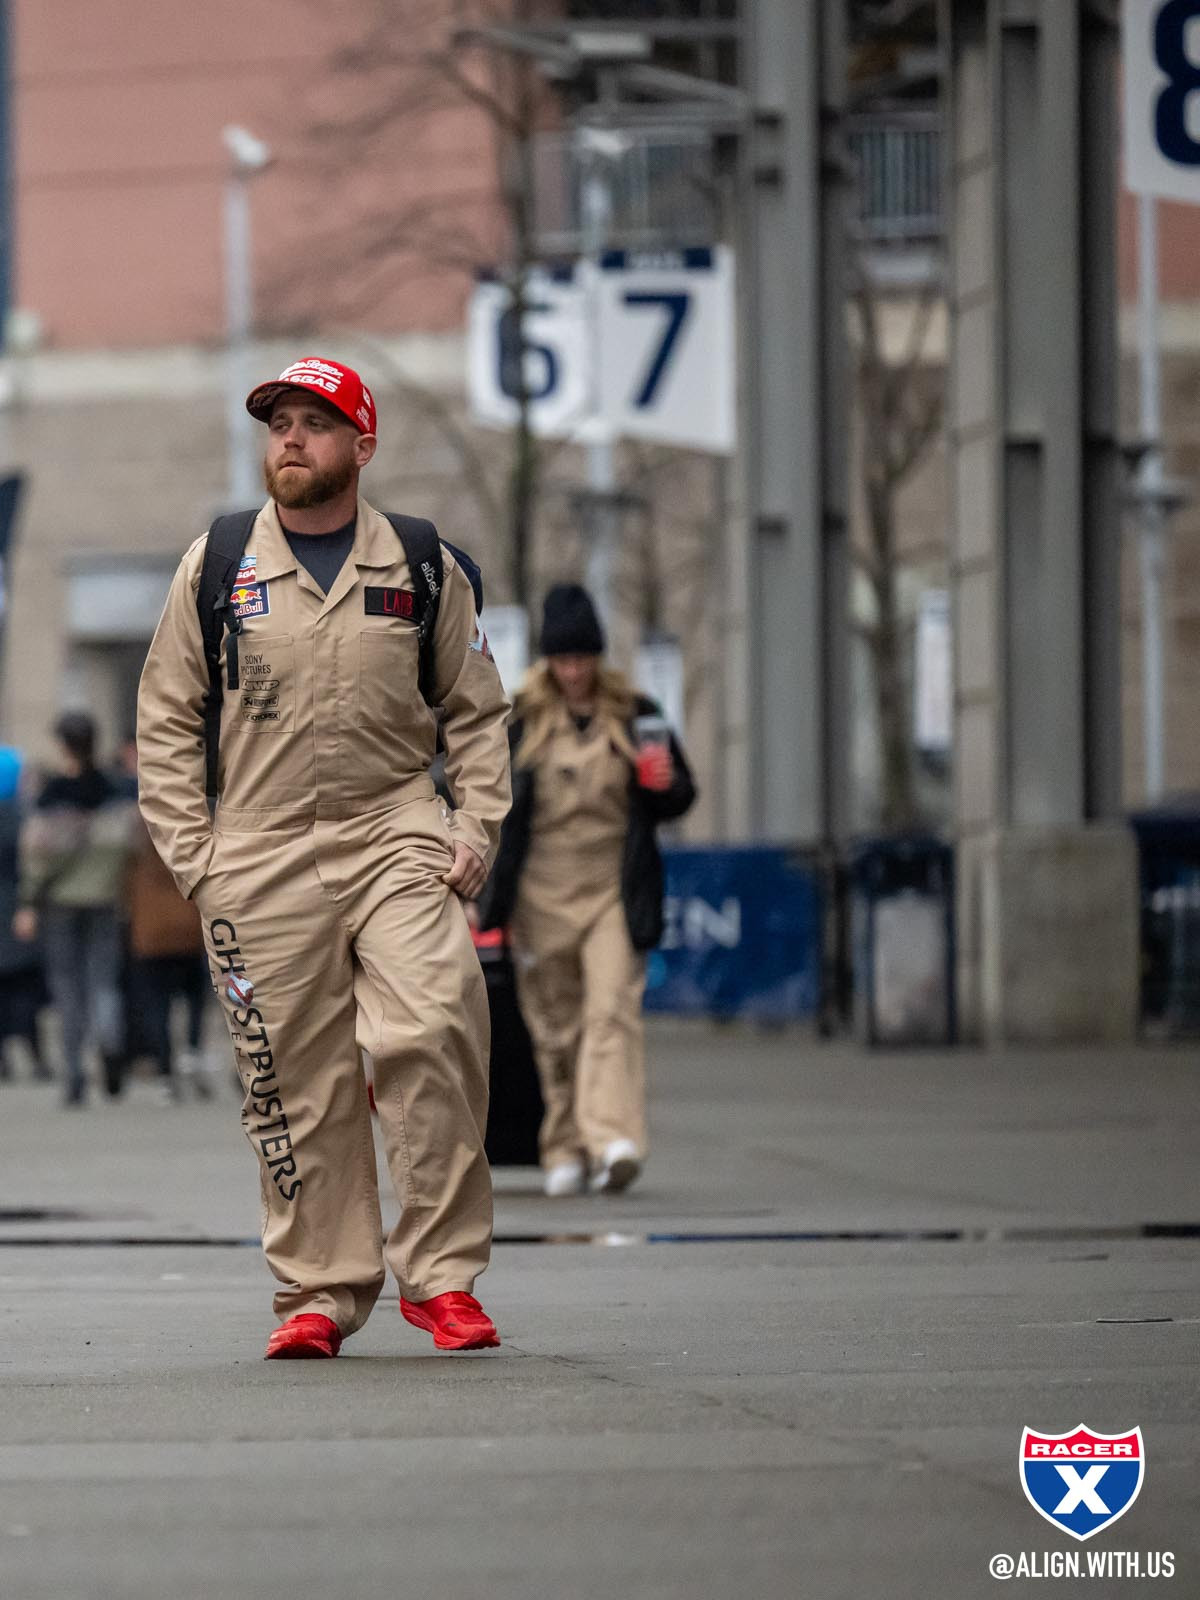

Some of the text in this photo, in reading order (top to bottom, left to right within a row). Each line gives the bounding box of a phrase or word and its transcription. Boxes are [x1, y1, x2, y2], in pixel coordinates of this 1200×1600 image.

[495, 302, 558, 400] 6
[622, 292, 690, 408] 7
[244, 601, 264, 615] Bull
[244, 654, 263, 664] SONY
